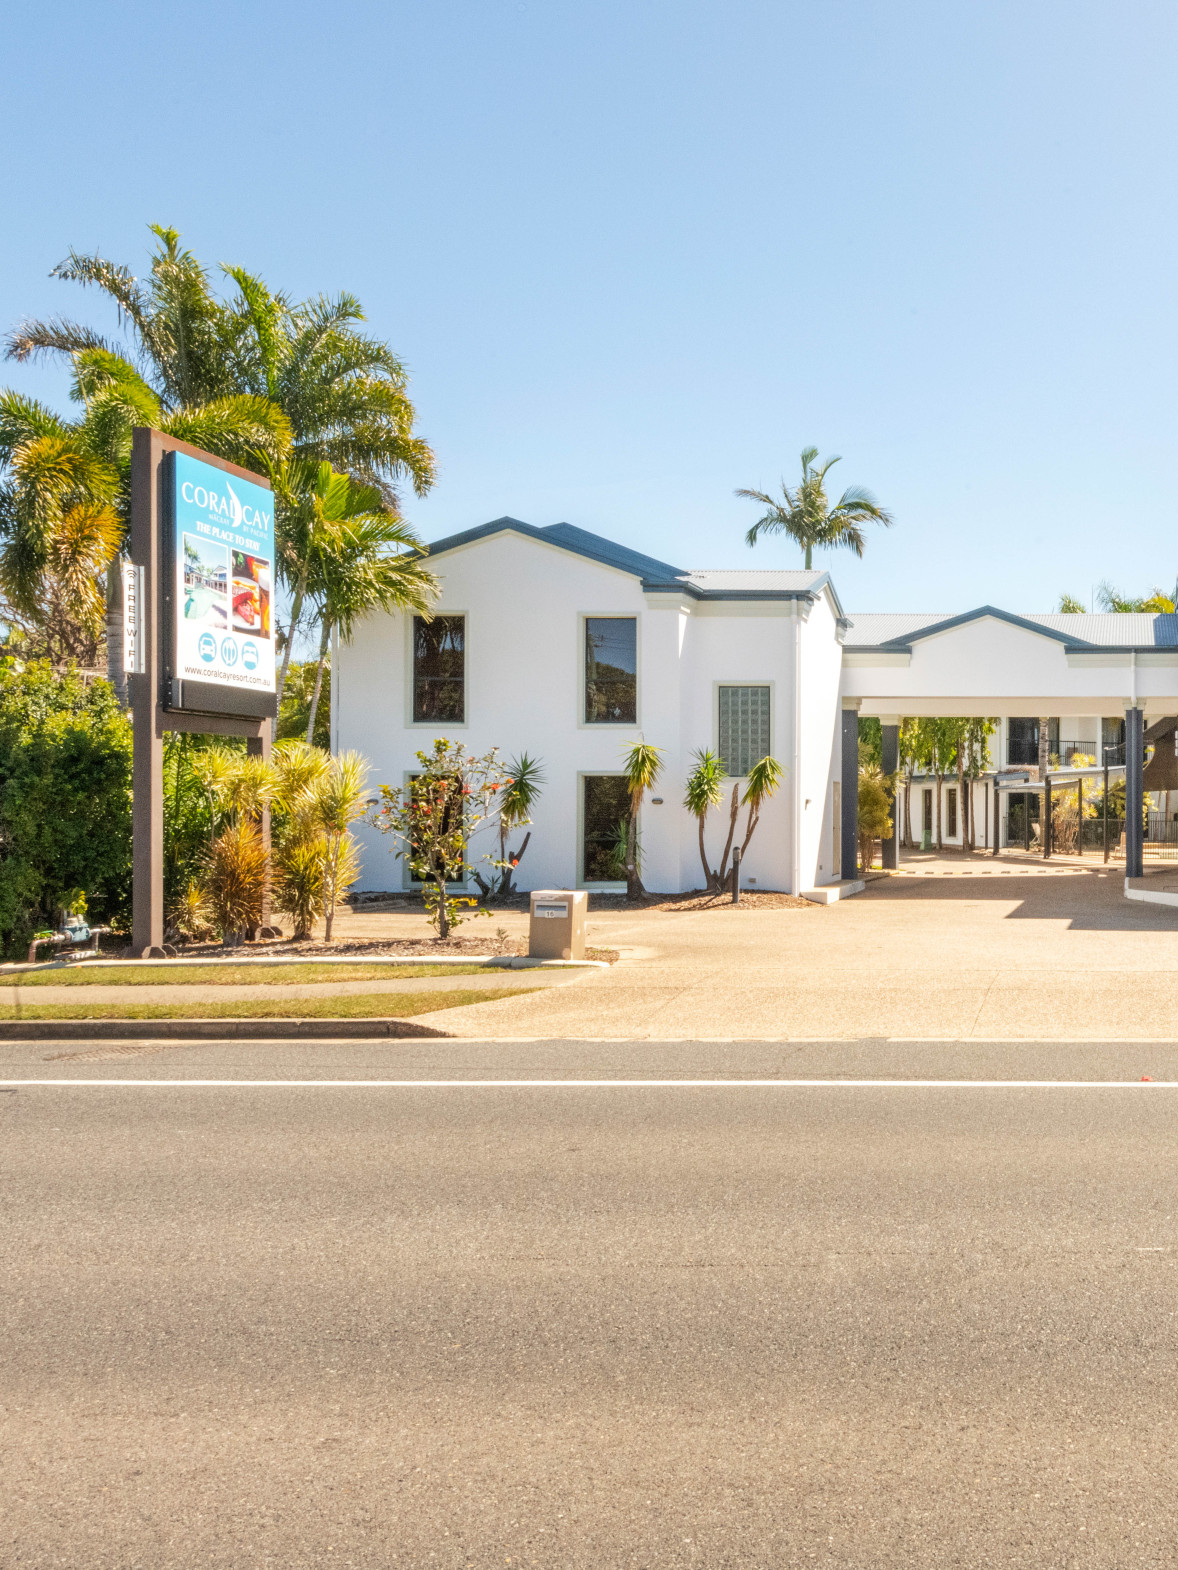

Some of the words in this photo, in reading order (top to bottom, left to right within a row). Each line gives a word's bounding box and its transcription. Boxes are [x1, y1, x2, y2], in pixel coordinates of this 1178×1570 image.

[182, 482, 236, 519] CORAL
[243, 505, 270, 531] CAY
[196, 521, 212, 535] THE
[212, 526, 235, 543] PLACE
[234, 534, 245, 546] TO
[245, 538, 262, 552] STAY
[128, 583, 136, 624] FREE
[184, 666, 271, 687] www.coralcayresort.com.au
